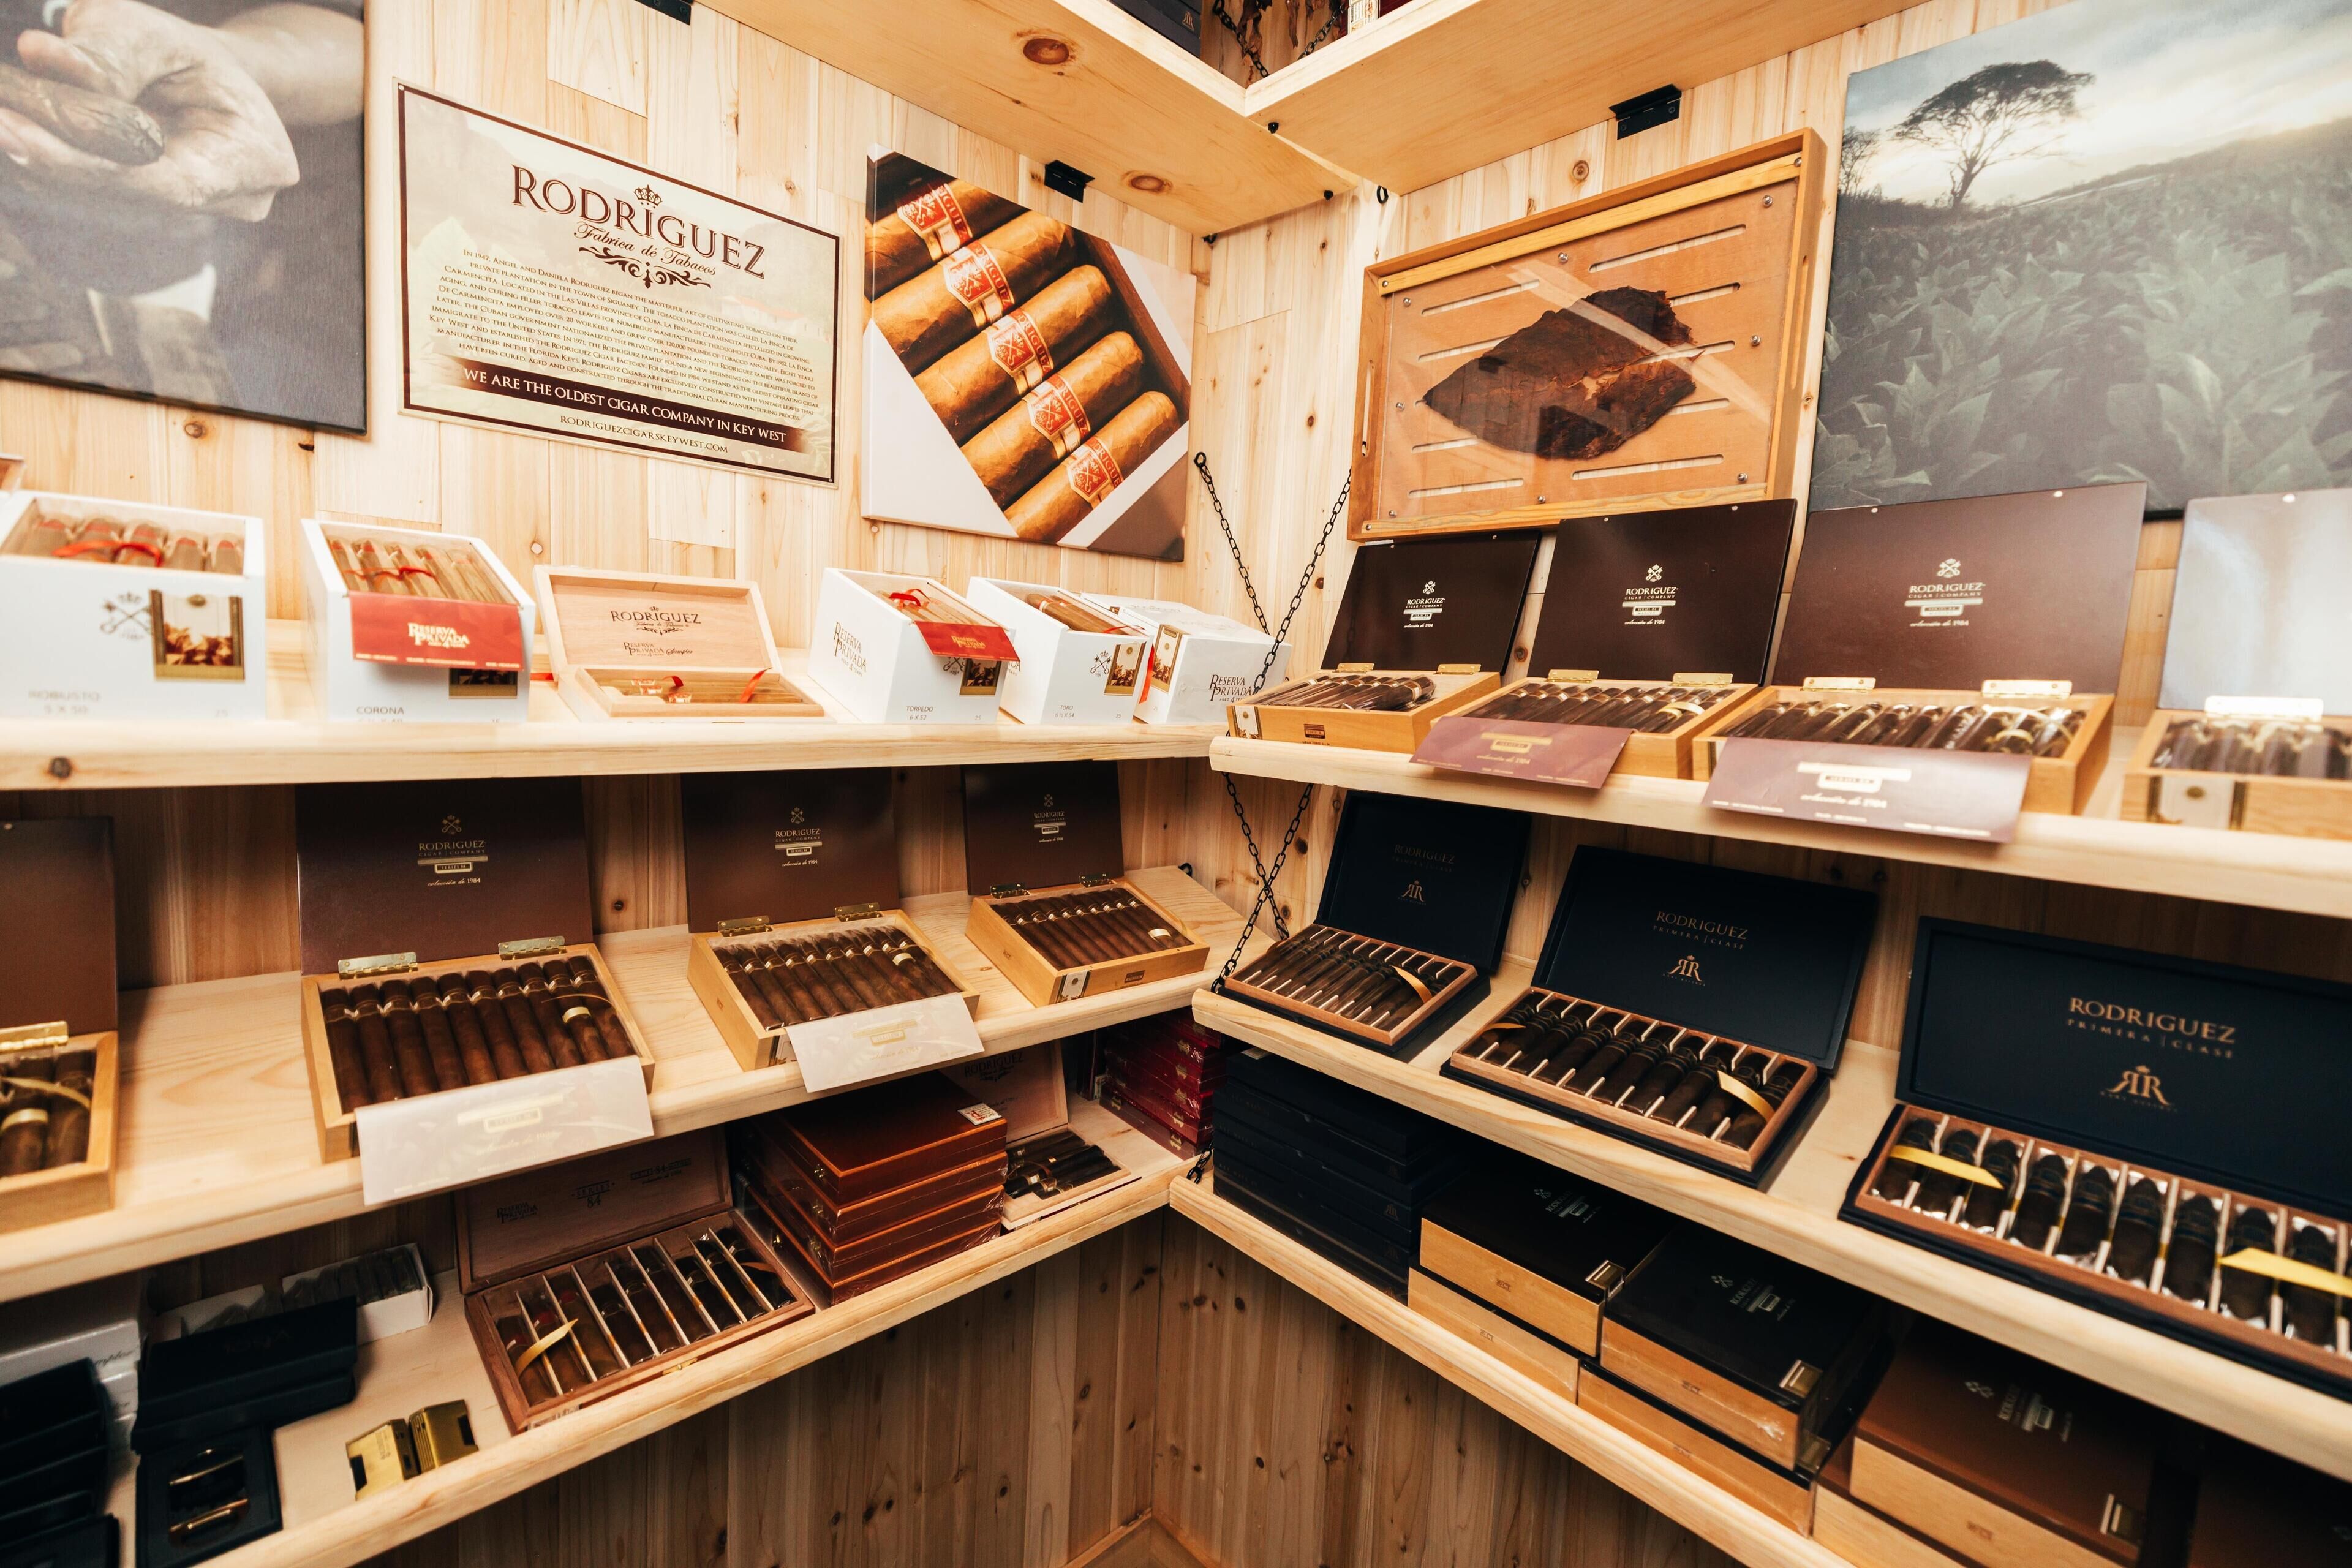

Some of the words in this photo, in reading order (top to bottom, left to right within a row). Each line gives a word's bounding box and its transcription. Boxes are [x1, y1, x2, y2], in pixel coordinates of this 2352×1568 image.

[511, 164, 765, 279] RODRIGUEZ
[573, 219, 634, 254] Fabrica
[662, 246, 715, 278] Tabacos
[464, 249, 473, 257] IN
[492, 257, 518, 269] ANGEL
[519, 265, 537, 274] AND
[538, 268, 568, 282] DANIELA
[570, 277, 610, 293] RODRIGUEZ
[611, 289, 633, 300] BEGAN
[633, 295, 647, 303] THE
[647, 298, 684, 313] MASTERFUL
[706, 315, 744, 329] CULTIVATING
[745, 325, 771, 336] TOBACCO
[782, 335, 797, 344] THEIR
[470, 262, 500, 274] PRIVATE
[501, 270, 547, 287] PLANTATION
[557, 284, 572, 293] THE
[573, 288, 595, 299] TOWN
[641, 306, 655, 315] THE
[656, 311, 686, 323] TOBACCO
[687, 318, 723, 333] PLANTATION
[769, 340, 786, 349] FINCA
[501, 279, 535, 294] LOCATED
[562, 295, 575, 304] LAS
[576, 298, 599, 310] VILLAS
[600, 305, 633, 318] PROVINCE
[672, 323, 692, 333] FINCA
[702, 331, 742, 346] CARMENCITA
[742, 342, 775, 355] SPECIALIZED
[464, 368, 488, 384] WE
[491, 372, 520, 391] ARE
[523, 379, 551, 397] THE
[554, 385, 603, 407] OLDEST
[608, 396, 648, 416] CIGAR
[652, 405, 714, 428] COMPANY
[717, 418, 730, 432] IN
[733, 421, 755, 437] KEY
[758, 427, 786, 443] WEST
[560, 415, 728, 453] RODRIGUEZCIGARSKEYWEST.COM
[1626, 587, 1676, 595] RODRIGUEZ
[1910, 582, 1983, 593] RODRIGUEZ
[611, 610, 701, 624] RODRIGUEZ
[407, 622, 457, 637] RESERVA
[415, 632, 470, 646] PRIVADA
[834, 622, 861, 654] RESERVA
[834, 638, 867, 672] PRIVADA
[1209, 674, 1245, 690] RESERVA
[1210, 686, 1252, 701] PRIVADA
[775, 828, 820, 837] RODRIGUEZ
[419, 840, 484, 851] RODRIGUEZ
[1395, 844, 1455, 864] RODRIGUEZ
[1653, 925, 1698, 940] PRIMERA
[1711, 938, 1743, 949] CLASE
[1656, 911, 1748, 940] RODRIGUEZ
[2070, 997, 2236, 1044] RODRIGUEZ
[2068, 1019, 2150, 1042] PRIMERA
[2171, 1040, 2233, 1059] CLASE
[576, 1182, 610, 1197] SERIES
[587, 1195, 601, 1208] 84
